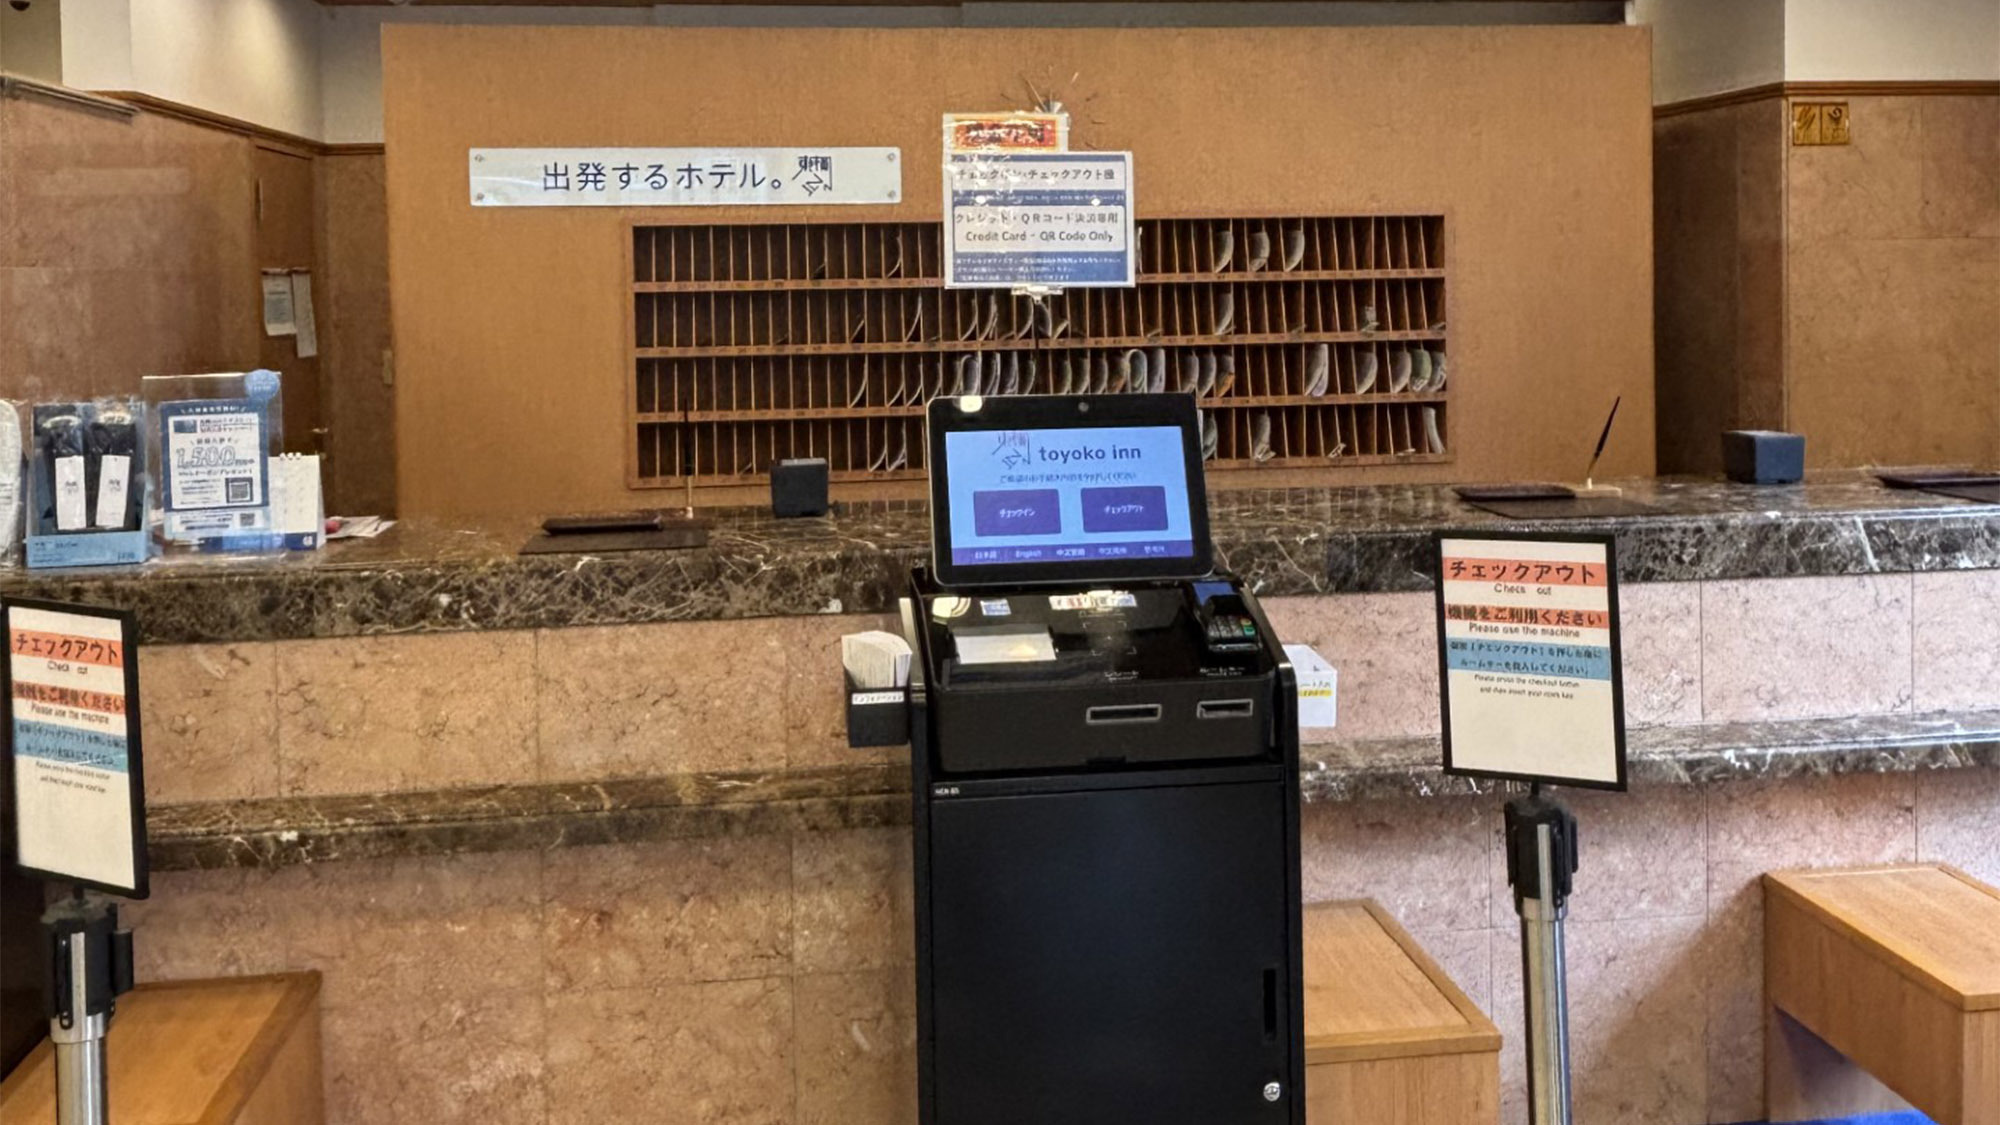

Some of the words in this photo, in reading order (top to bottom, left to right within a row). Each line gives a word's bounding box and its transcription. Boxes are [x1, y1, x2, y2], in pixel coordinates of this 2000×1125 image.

[543, 161, 782, 191] 出発するホテル。
[965, 231, 998, 242] Credit
[1002, 232, 1027, 242] Card
[1039, 231, 1056, 242] QR
[1059, 231, 1086, 242] Code
[1088, 231, 1113, 243] Only
[1038, 445, 1106, 464] toyoko
[1112, 444, 1142, 460] inn
[1450, 560, 1595, 584] チェックアウト
[1494, 583, 1526, 594] Check
[1536, 586, 1552, 596] out
[1447, 603, 1602, 626] 機械をご利用ください
[1469, 622, 1499, 634] Please
[1502, 627, 1520, 635] use
[1522, 626, 1538, 636] the
[1541, 627, 1580, 638] machine
[16, 633, 118, 664] チェックアウト
